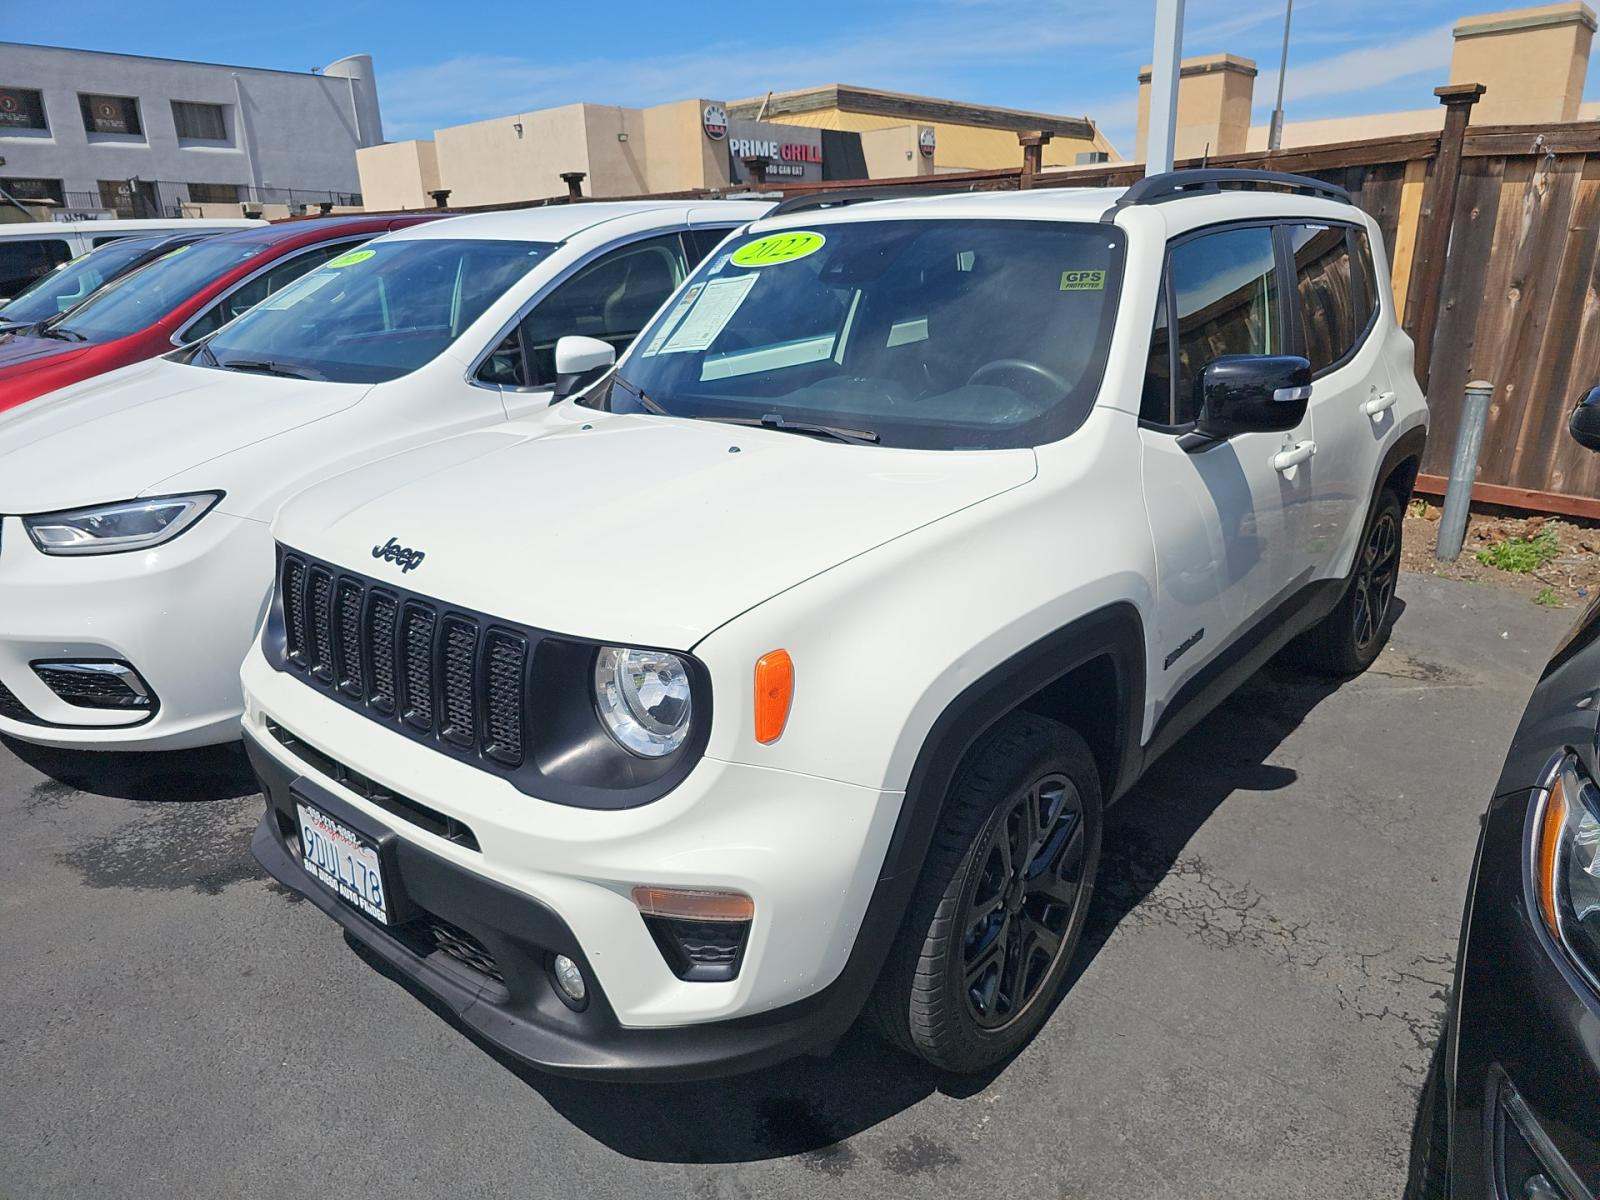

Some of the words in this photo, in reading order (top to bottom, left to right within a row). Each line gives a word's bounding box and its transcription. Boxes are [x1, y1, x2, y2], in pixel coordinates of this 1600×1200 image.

[730, 139, 778, 159] PRIME
[781, 144, 821, 163] GRILL
[779, 166, 791, 175] CAN
[792, 166, 803, 176] EAT
[741, 236, 812, 261] 2022
[1066, 272, 1101, 282] GPS
[372, 537, 425, 574] Jeep
[304, 825, 382, 908] 9DUL178
[304, 858, 318, 878] SAN
[318, 866, 340, 892] DIEGO
[339, 882, 360, 906] AUTO
[360, 896, 388, 926] FINDER
